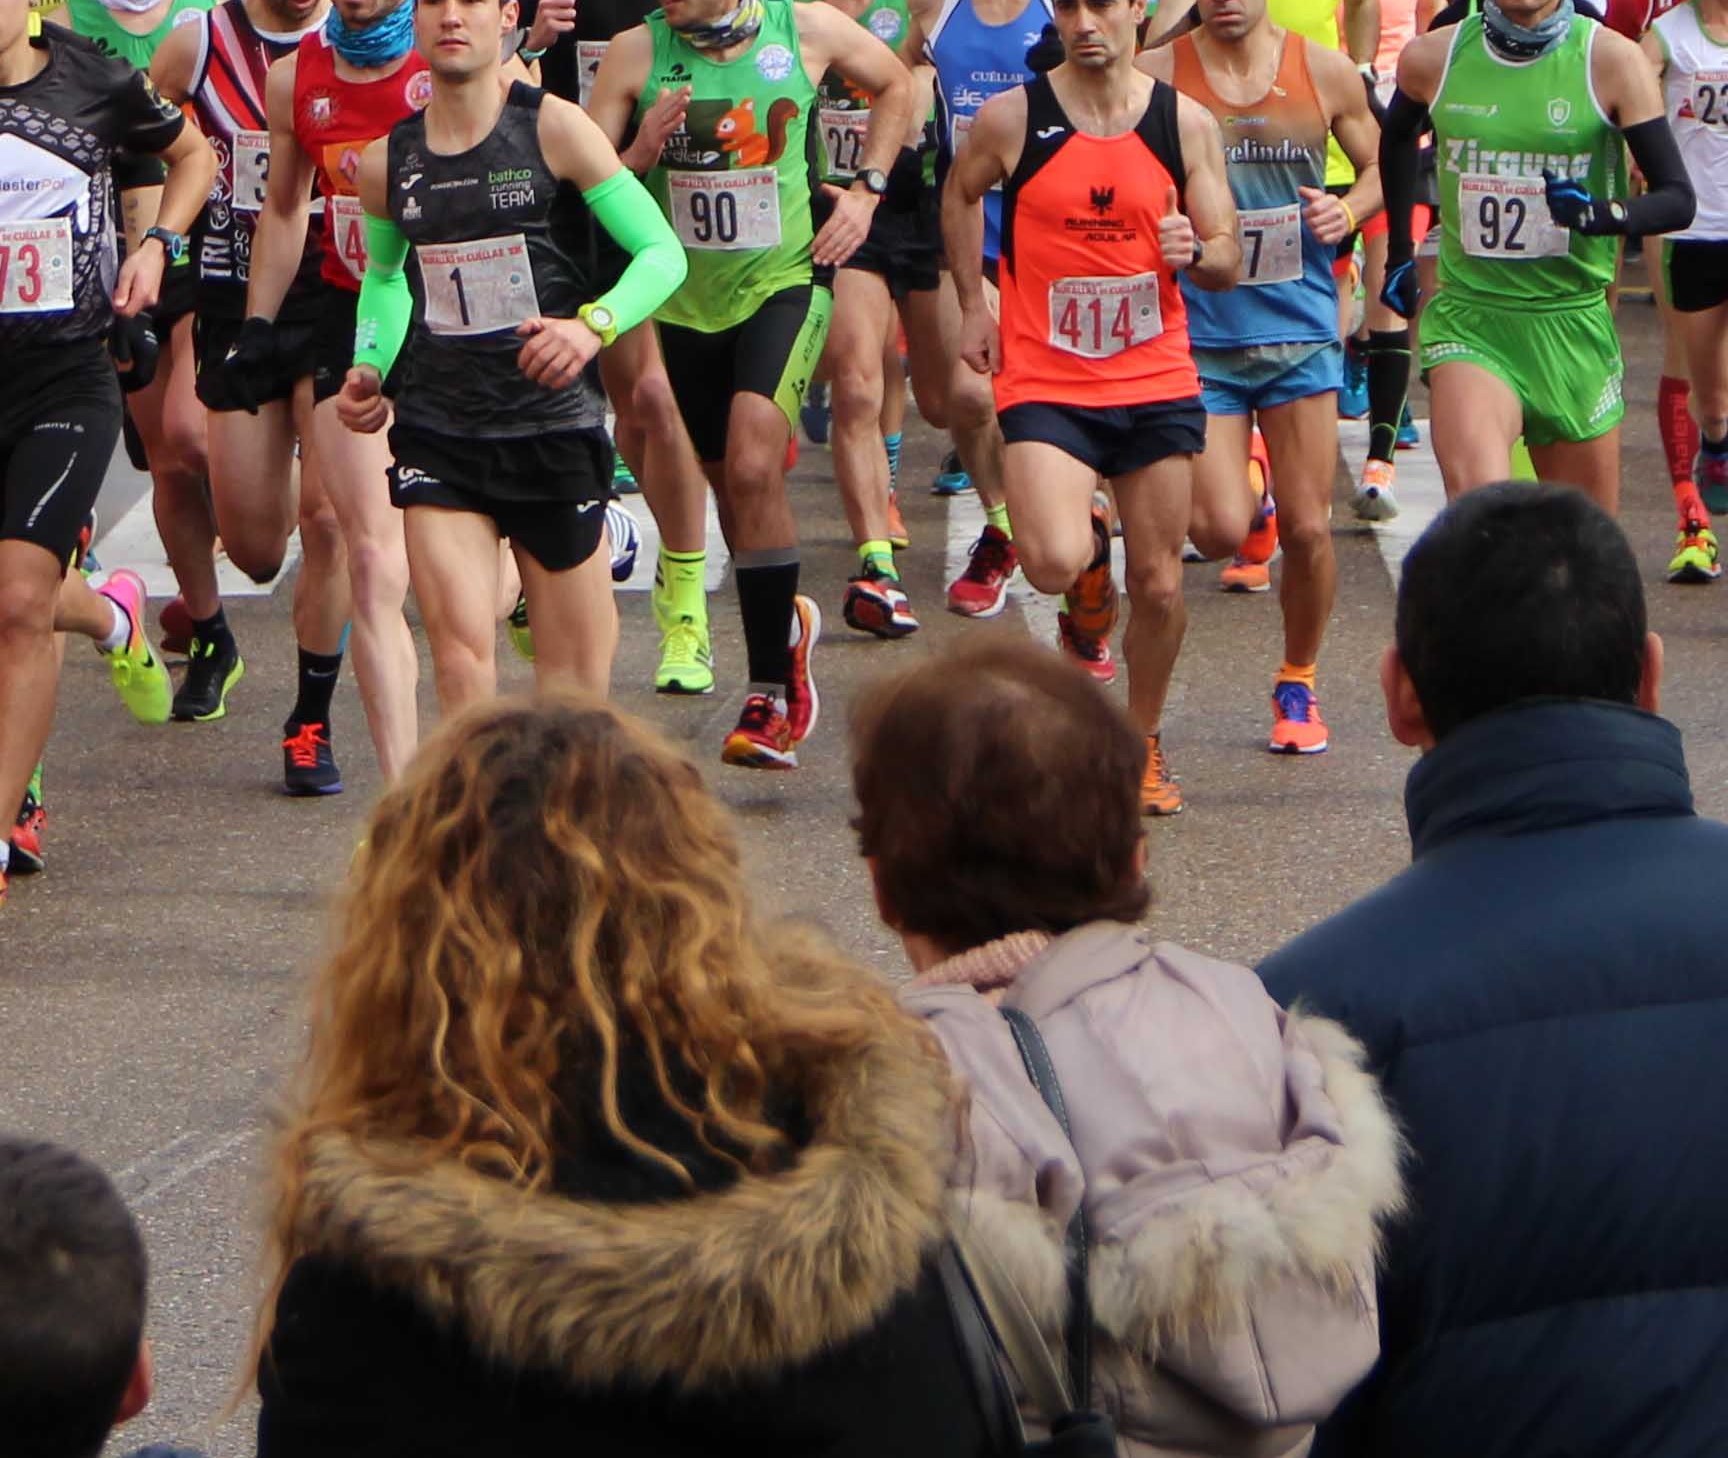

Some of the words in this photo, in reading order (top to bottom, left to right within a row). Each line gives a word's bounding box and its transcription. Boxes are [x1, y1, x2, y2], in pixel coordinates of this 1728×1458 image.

[828, 127, 860, 171] 22
[489, 168, 532, 183] bathco
[489, 190, 535, 209] TEAM
[690, 191, 738, 243] 90
[1479, 196, 1527, 251] 92
[200, 235, 232, 279] TRI
[1244, 230, 1263, 278] 7
[450, 268, 470, 326] 1
[1059, 297, 1135, 350] 414
